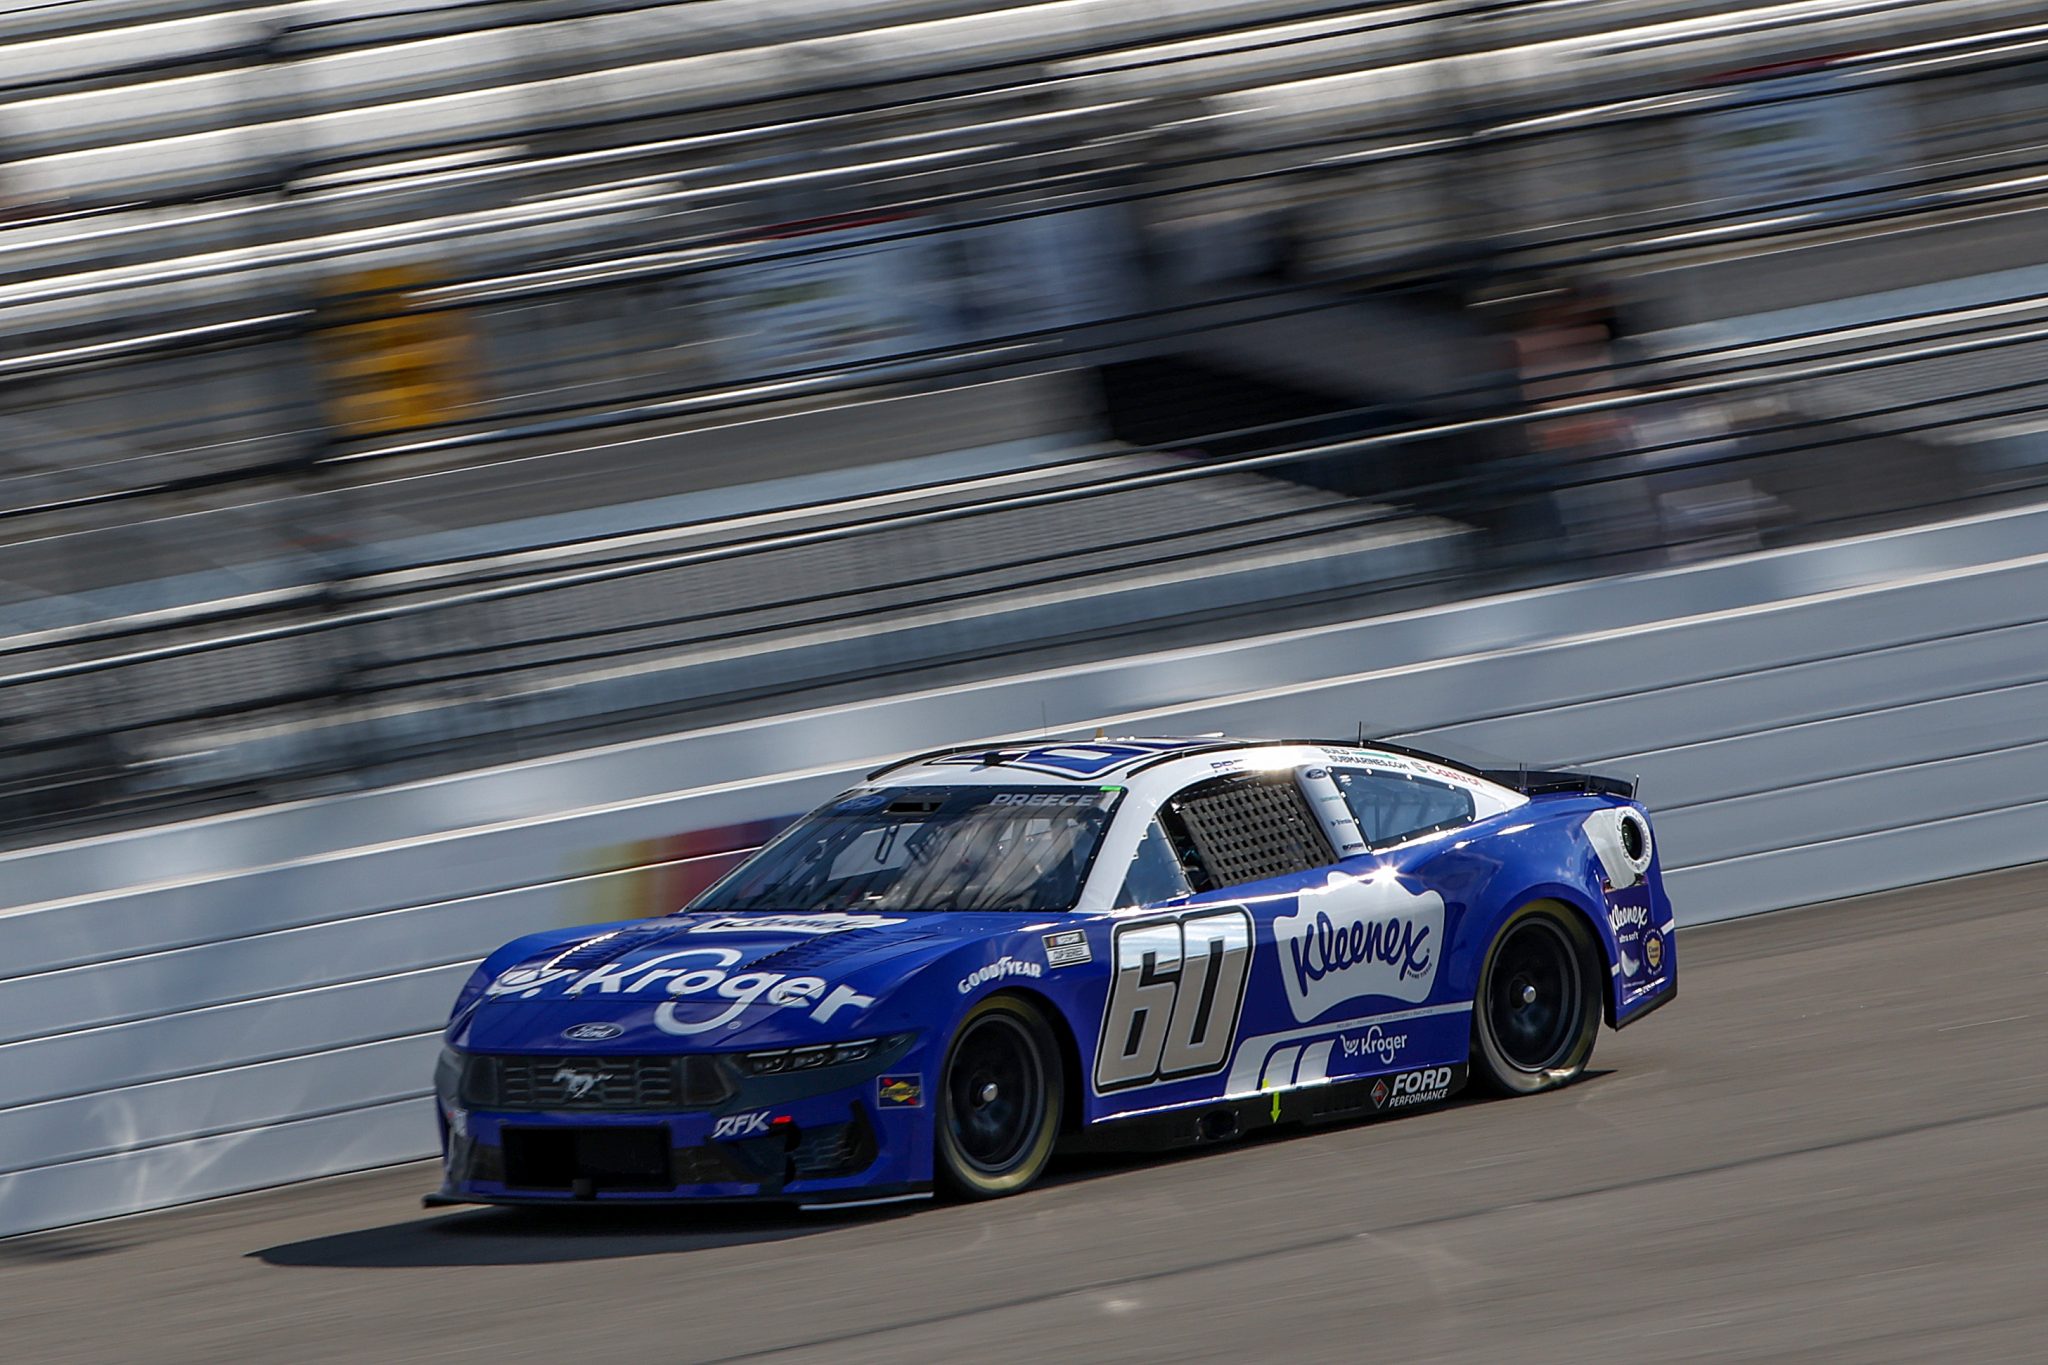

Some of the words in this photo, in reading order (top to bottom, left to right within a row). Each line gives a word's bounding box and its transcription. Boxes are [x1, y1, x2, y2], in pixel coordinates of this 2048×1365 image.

[1329, 755, 1409, 770] SUBMARINES.COM
[1426, 766, 1485, 788] Castrol
[990, 793, 1098, 807] PREECE
[1609, 904, 1647, 936] Kleenex
[1290, 911, 1431, 997] Kleenex
[958, 956, 1042, 994] GOODYEAR
[563, 948, 877, 1035] Kroger
[1092, 905, 1256, 1098] 60
[570, 1024, 616, 1038] Ford
[1361, 1025, 1408, 1065] Kroger
[1392, 1067, 1452, 1097] FORD
[1388, 1088, 1449, 1108] PERFORMANCE
[711, 1110, 771, 1139] RFK
